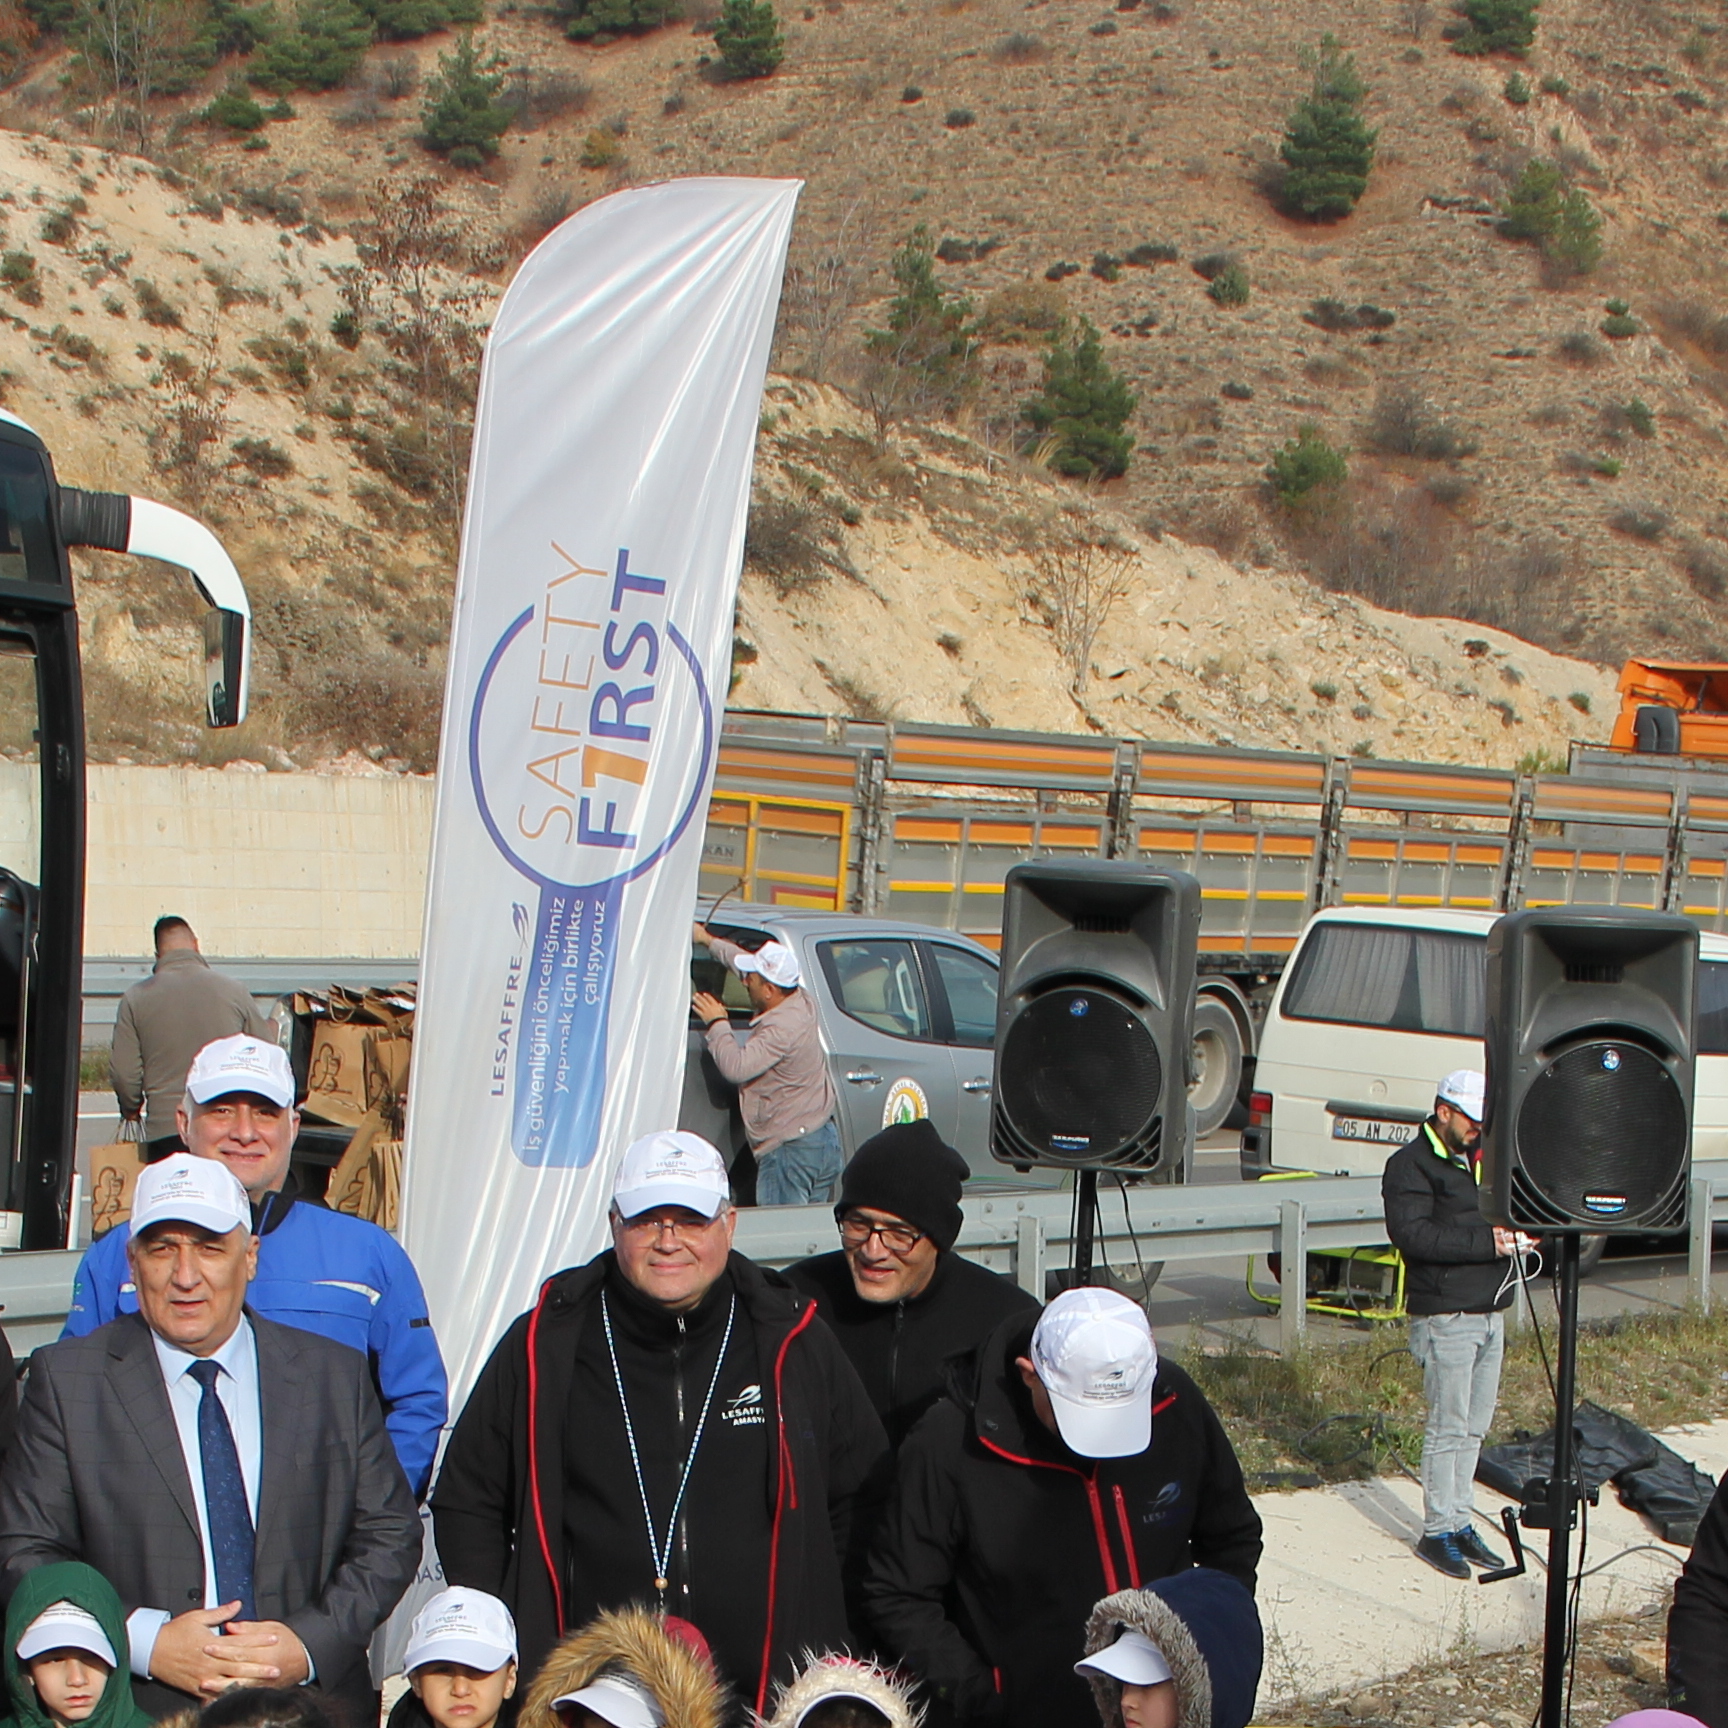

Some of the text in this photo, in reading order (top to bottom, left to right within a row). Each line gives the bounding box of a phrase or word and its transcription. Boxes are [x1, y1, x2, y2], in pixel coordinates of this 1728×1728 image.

[519, 540, 608, 844] SAFETY
[532, 897, 566, 1014] önceliğimiz
[554, 899, 584, 1093] yapmak için birlikte
[582, 900, 606, 1005] çalışıyoruz
[491, 956, 522, 1096] LESAFFRE
[527, 1018, 551, 1131] güvenliğini
